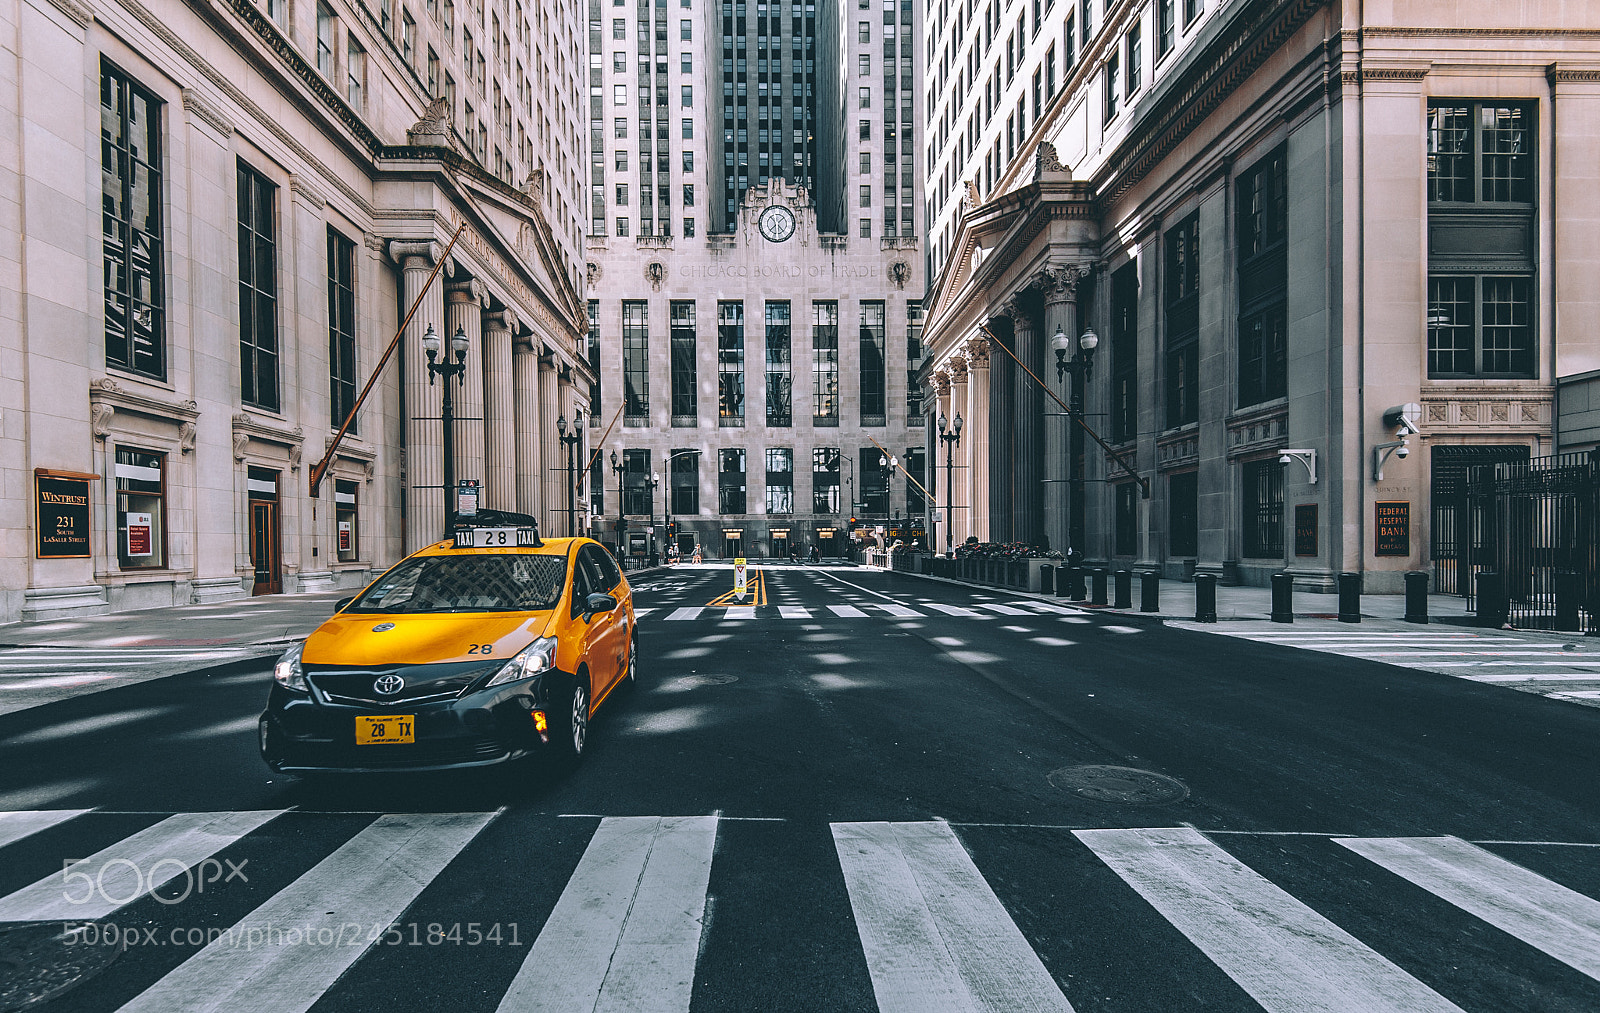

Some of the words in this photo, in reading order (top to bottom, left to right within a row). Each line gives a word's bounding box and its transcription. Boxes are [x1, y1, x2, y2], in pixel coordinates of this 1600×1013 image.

[679, 265, 748, 278] CHICAGO
[753, 265, 801, 278] BOARD
[808, 265, 827, 278] OF
[833, 265, 878, 278] TRADE
[500, 261, 534, 311] FINANCIAL
[41, 491, 87, 504] WINTRUST
[1379, 507, 1408, 515] FEDERAL
[56, 516, 74, 528] 231
[1379, 517, 1407, 525] RESERVE
[485, 531, 507, 545] 28
[517, 530, 535, 545] TAXI
[1381, 527, 1406, 536] BANK
[455, 531, 474, 546] TAXI
[467, 643, 493, 655] 28
[371, 723, 385, 737] 28
[398, 722, 412, 737] TX
